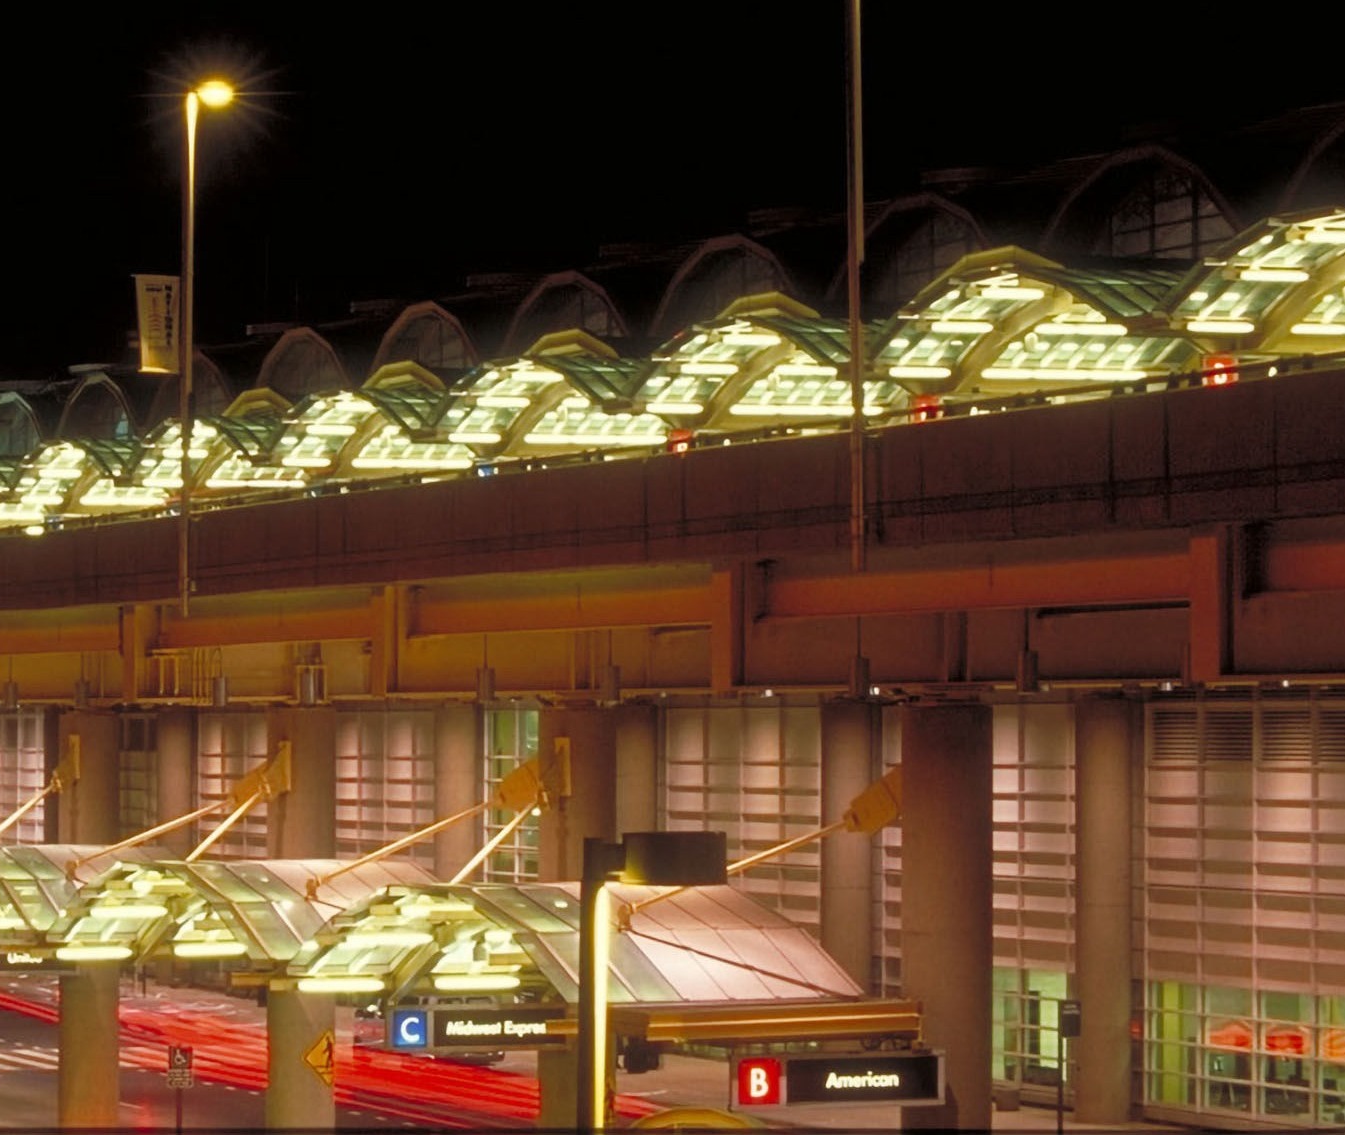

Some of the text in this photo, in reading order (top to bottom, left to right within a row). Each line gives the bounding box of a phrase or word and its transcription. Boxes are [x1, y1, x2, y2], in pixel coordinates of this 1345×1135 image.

[400, 1016, 420, 1043] C
[445, 1020, 502, 1036] Midwest
[750, 1067, 900, 1098] B American
